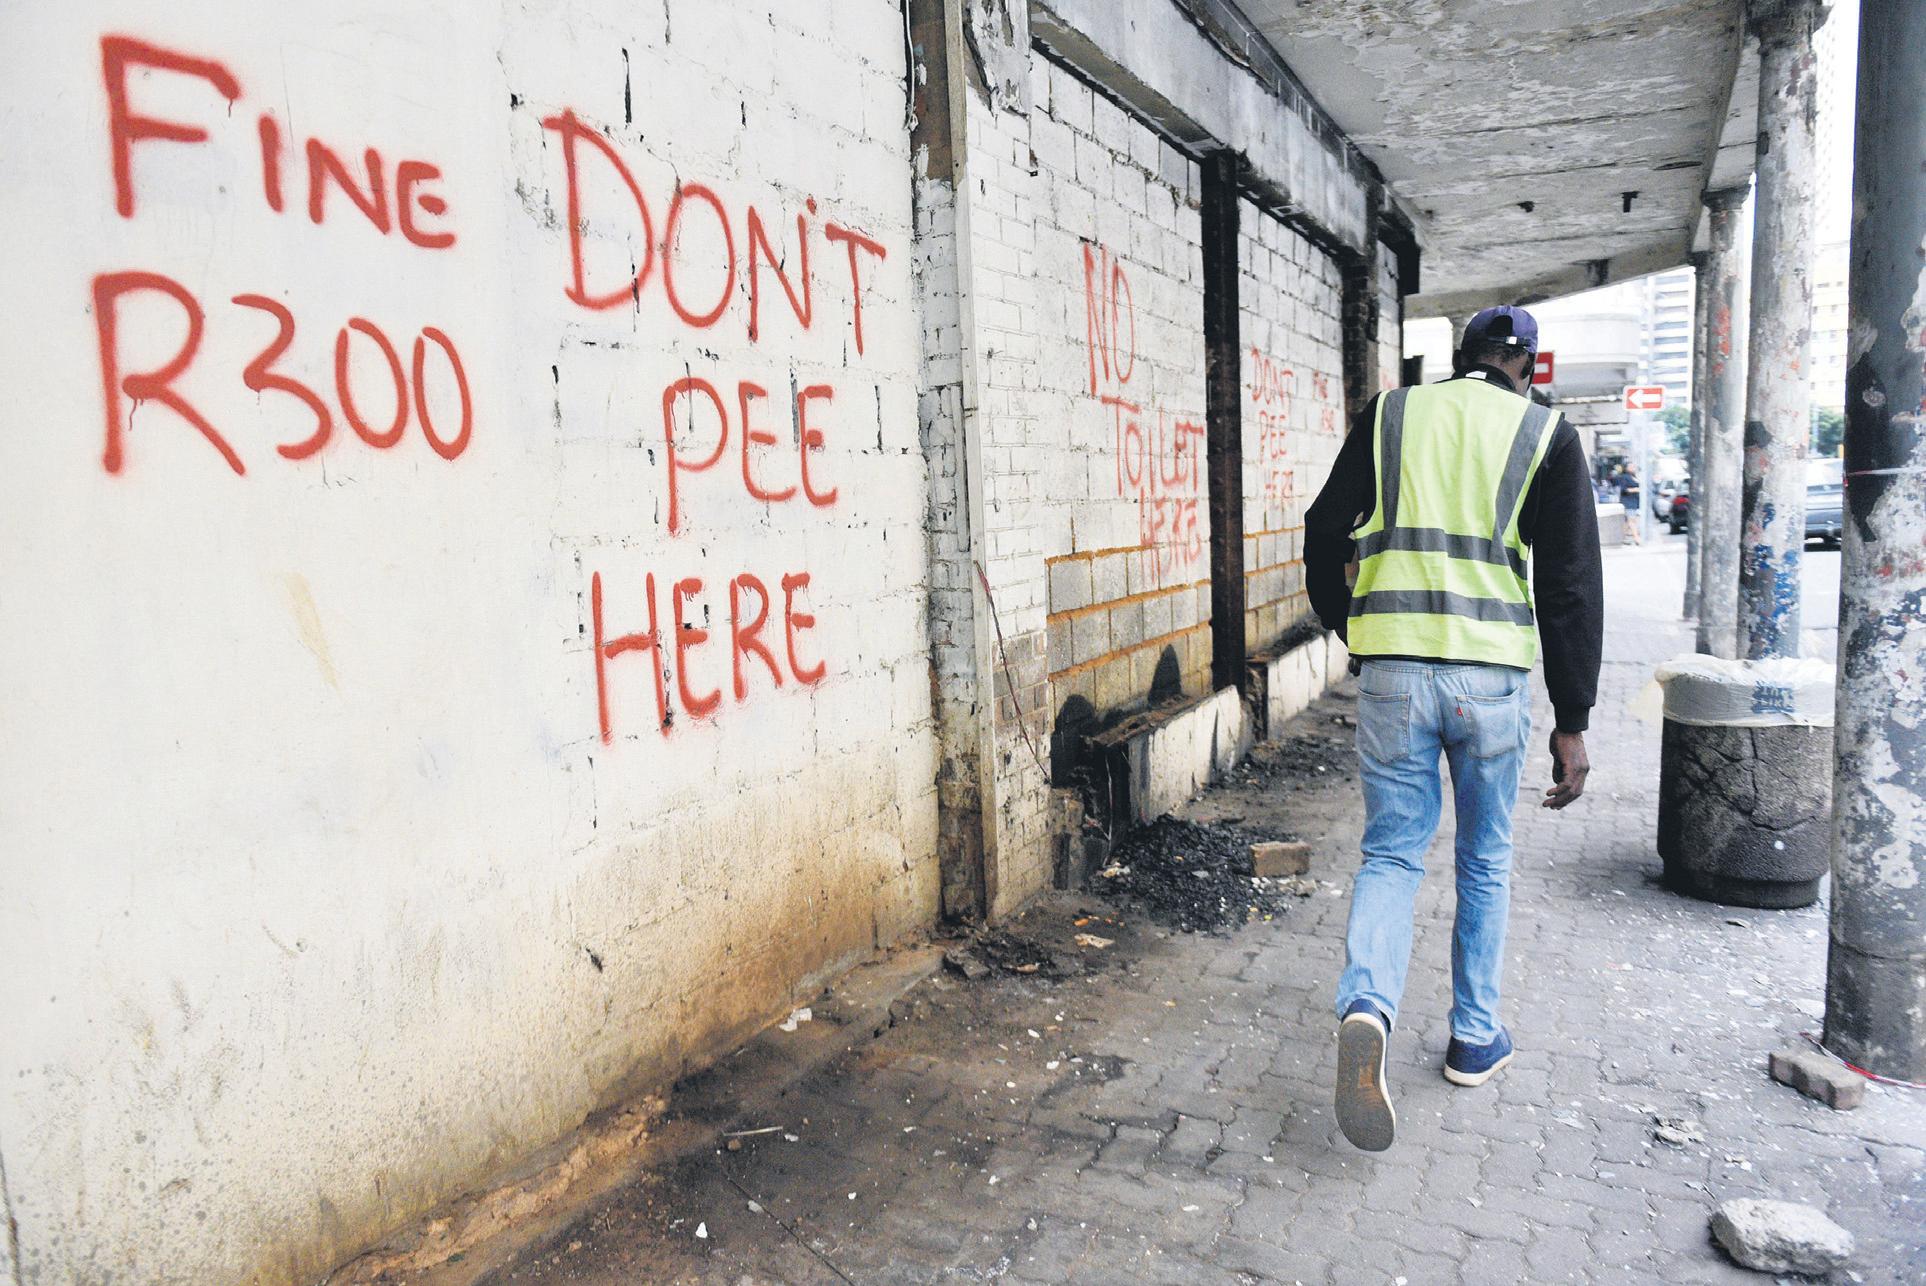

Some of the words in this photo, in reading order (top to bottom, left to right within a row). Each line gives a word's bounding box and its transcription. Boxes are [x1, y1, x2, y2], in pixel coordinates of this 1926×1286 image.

[98, 33, 458, 250] FINE
[91, 270, 474, 478] R300
[1083, 243, 1135, 398] NO
[661, 378, 839, 537] PEE
[1101, 395, 1205, 498] TOILET
[1137, 486, 1204, 585] HERE
[590, 571, 828, 745] HERE
